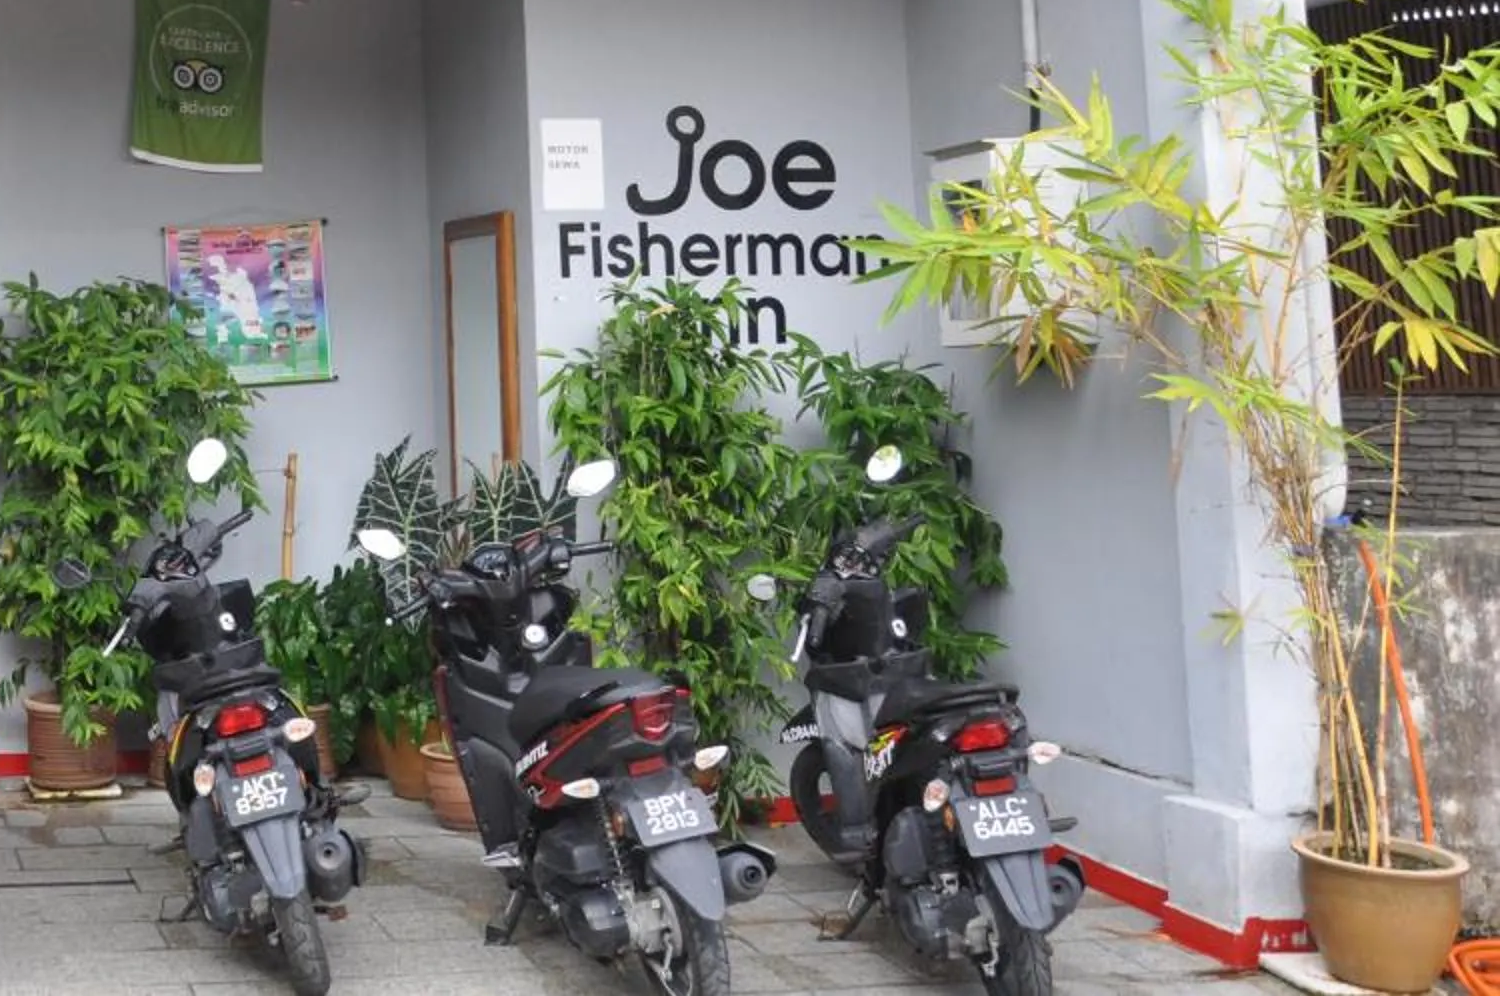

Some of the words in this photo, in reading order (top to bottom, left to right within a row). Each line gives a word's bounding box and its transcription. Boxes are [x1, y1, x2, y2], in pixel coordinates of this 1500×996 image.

[547, 145, 589, 154] MOTOR
[626, 105, 837, 216] Joe
[242, 771, 279, 797] AKT
[236, 787, 288, 815] 8357
[644, 791, 686, 816] BPY
[979, 797, 1022, 821] ALC
[646, 810, 699, 835] 2813
[973, 816, 1036, 839] 6445
